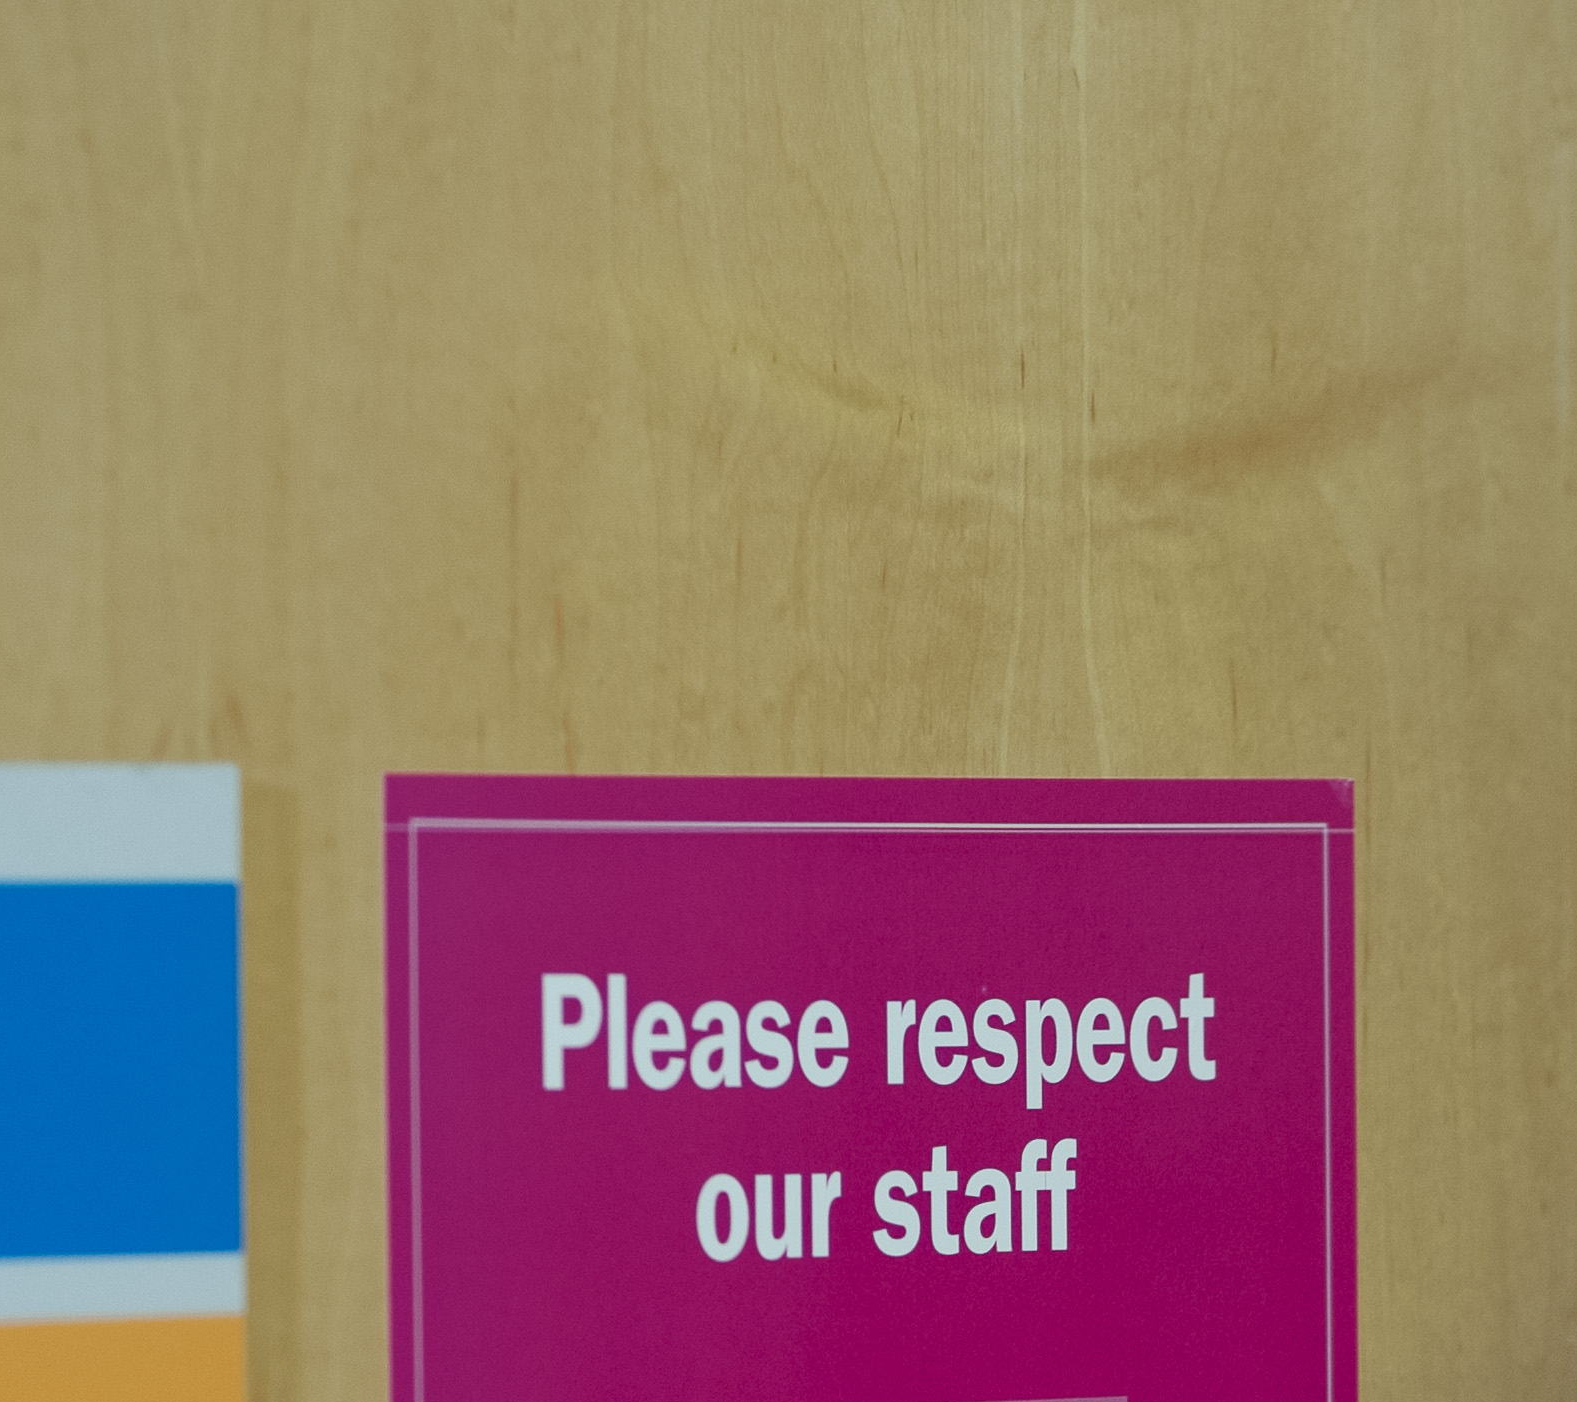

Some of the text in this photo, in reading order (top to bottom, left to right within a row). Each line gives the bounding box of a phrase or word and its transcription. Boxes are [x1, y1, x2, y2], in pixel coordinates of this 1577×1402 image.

[541, 972, 1217, 1110] Please respect
[696, 1137, 1078, 1263] our staff
